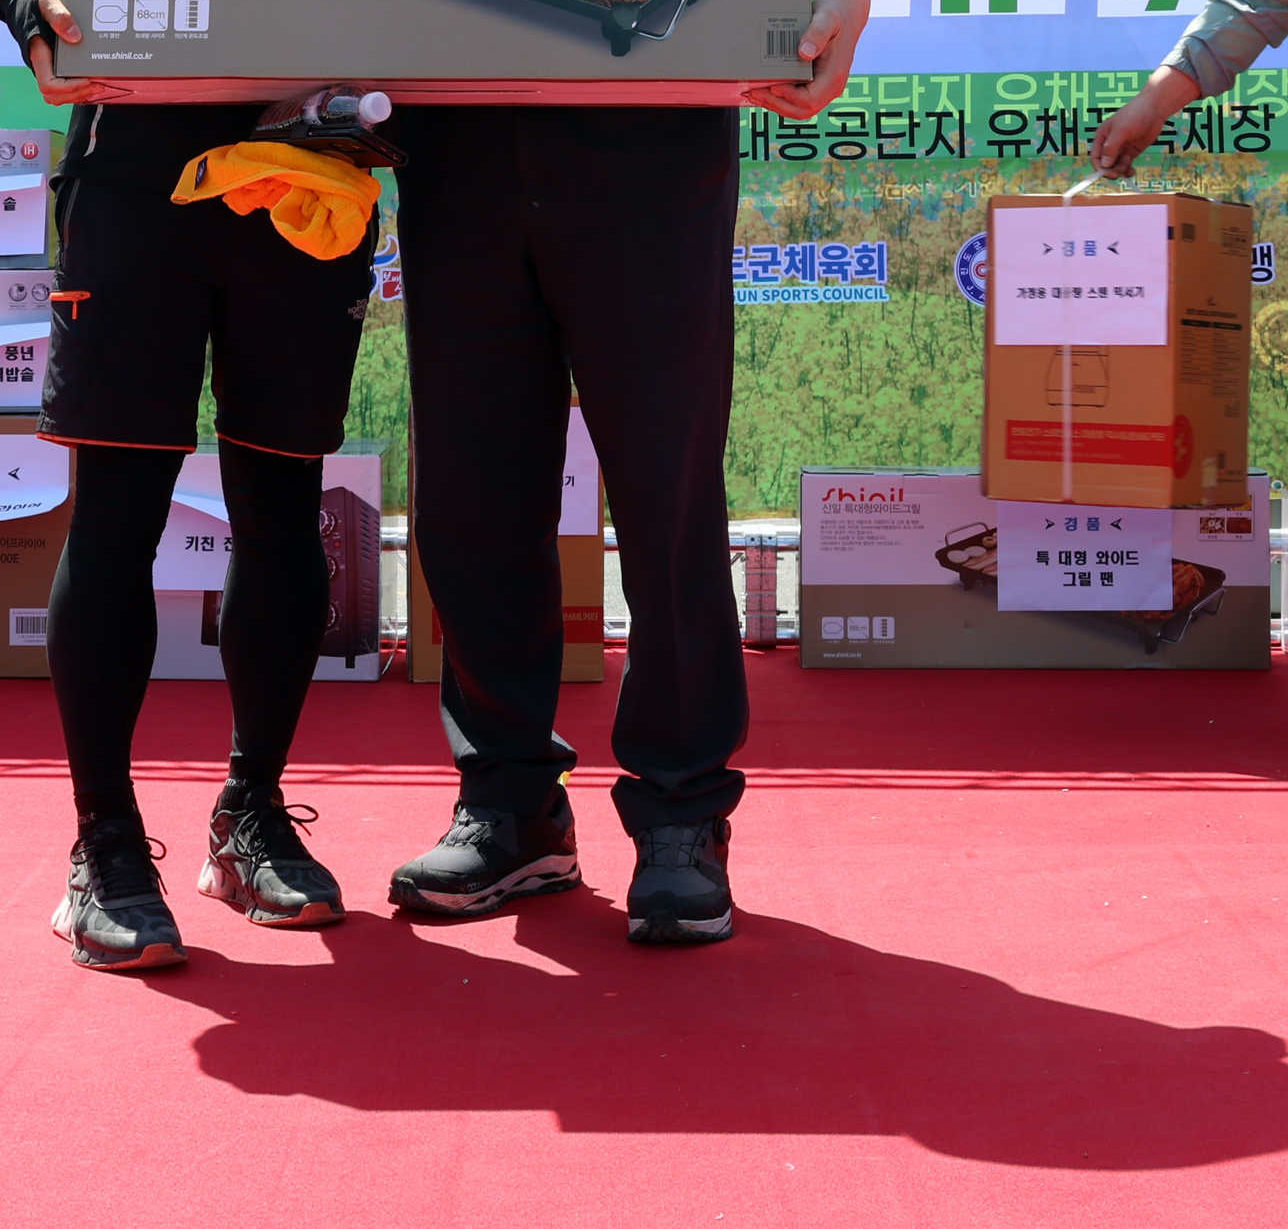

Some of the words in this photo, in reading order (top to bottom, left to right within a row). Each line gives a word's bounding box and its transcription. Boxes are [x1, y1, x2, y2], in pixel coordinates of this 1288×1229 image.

[137, 10, 165, 19] 68cm
[91, 52, 153, 60] www.shinil.co.kr
[3, 197, 16, 212] 솥
[1083, 240, 1097, 257] 품
[761, 287, 820, 304] SPORTS
[823, 286, 889, 302] COUNCIL
[5, 345, 34, 361] 풍년
[822, 488, 905, 502] Shinil
[822, 504, 841, 514] 신일
[844, 504, 920, 514] 특대형와이드그릴
[1064, 517, 1078, 532] 경
[1086, 517, 1101, 532] 품
[185, 535, 214, 552] 키친
[1036, 550, 1051, 566] 특
[1058, 550, 1088, 566] 대형
[1095, 550, 1140, 566] 와이드
[1063, 571, 1092, 587] 그릴
[1099, 571, 1114, 587] 팬
